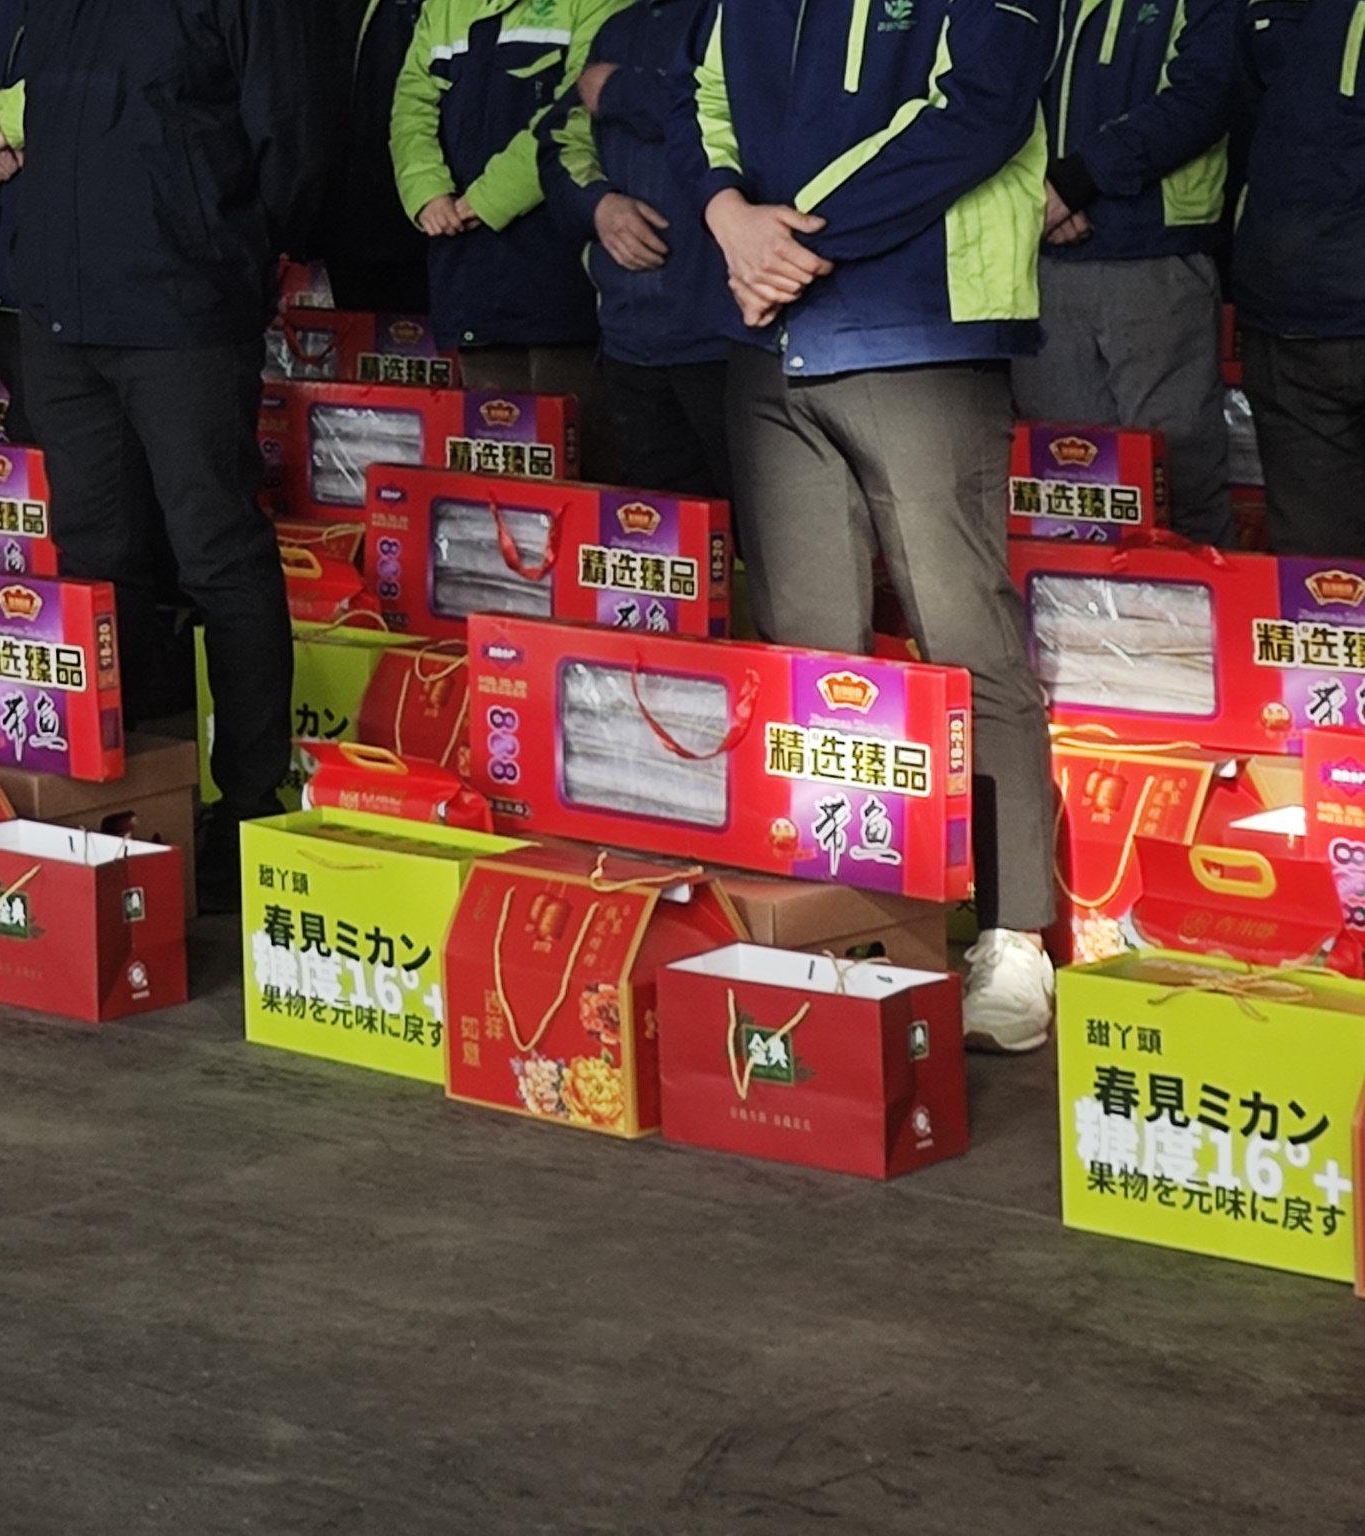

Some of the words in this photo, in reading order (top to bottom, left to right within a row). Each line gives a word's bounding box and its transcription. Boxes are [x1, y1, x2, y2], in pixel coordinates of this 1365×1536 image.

[446, 437, 555, 478] 精选臻品
[1010, 477, 1141, 524] 精选臻品
[580, 545, 698, 599] 精选臻品
[767, 724, 929, 794] 精选臻品
[259, 864, 310, 896] 甜丫頭
[264, 904, 432, 972] 春見ミカン
[1086, 1018, 1162, 1055] 甜丫頭
[1094, 1066, 1330, 1146] 春見ミカン
[1087, 1160, 1347, 1237] 果物を元味に戻す
